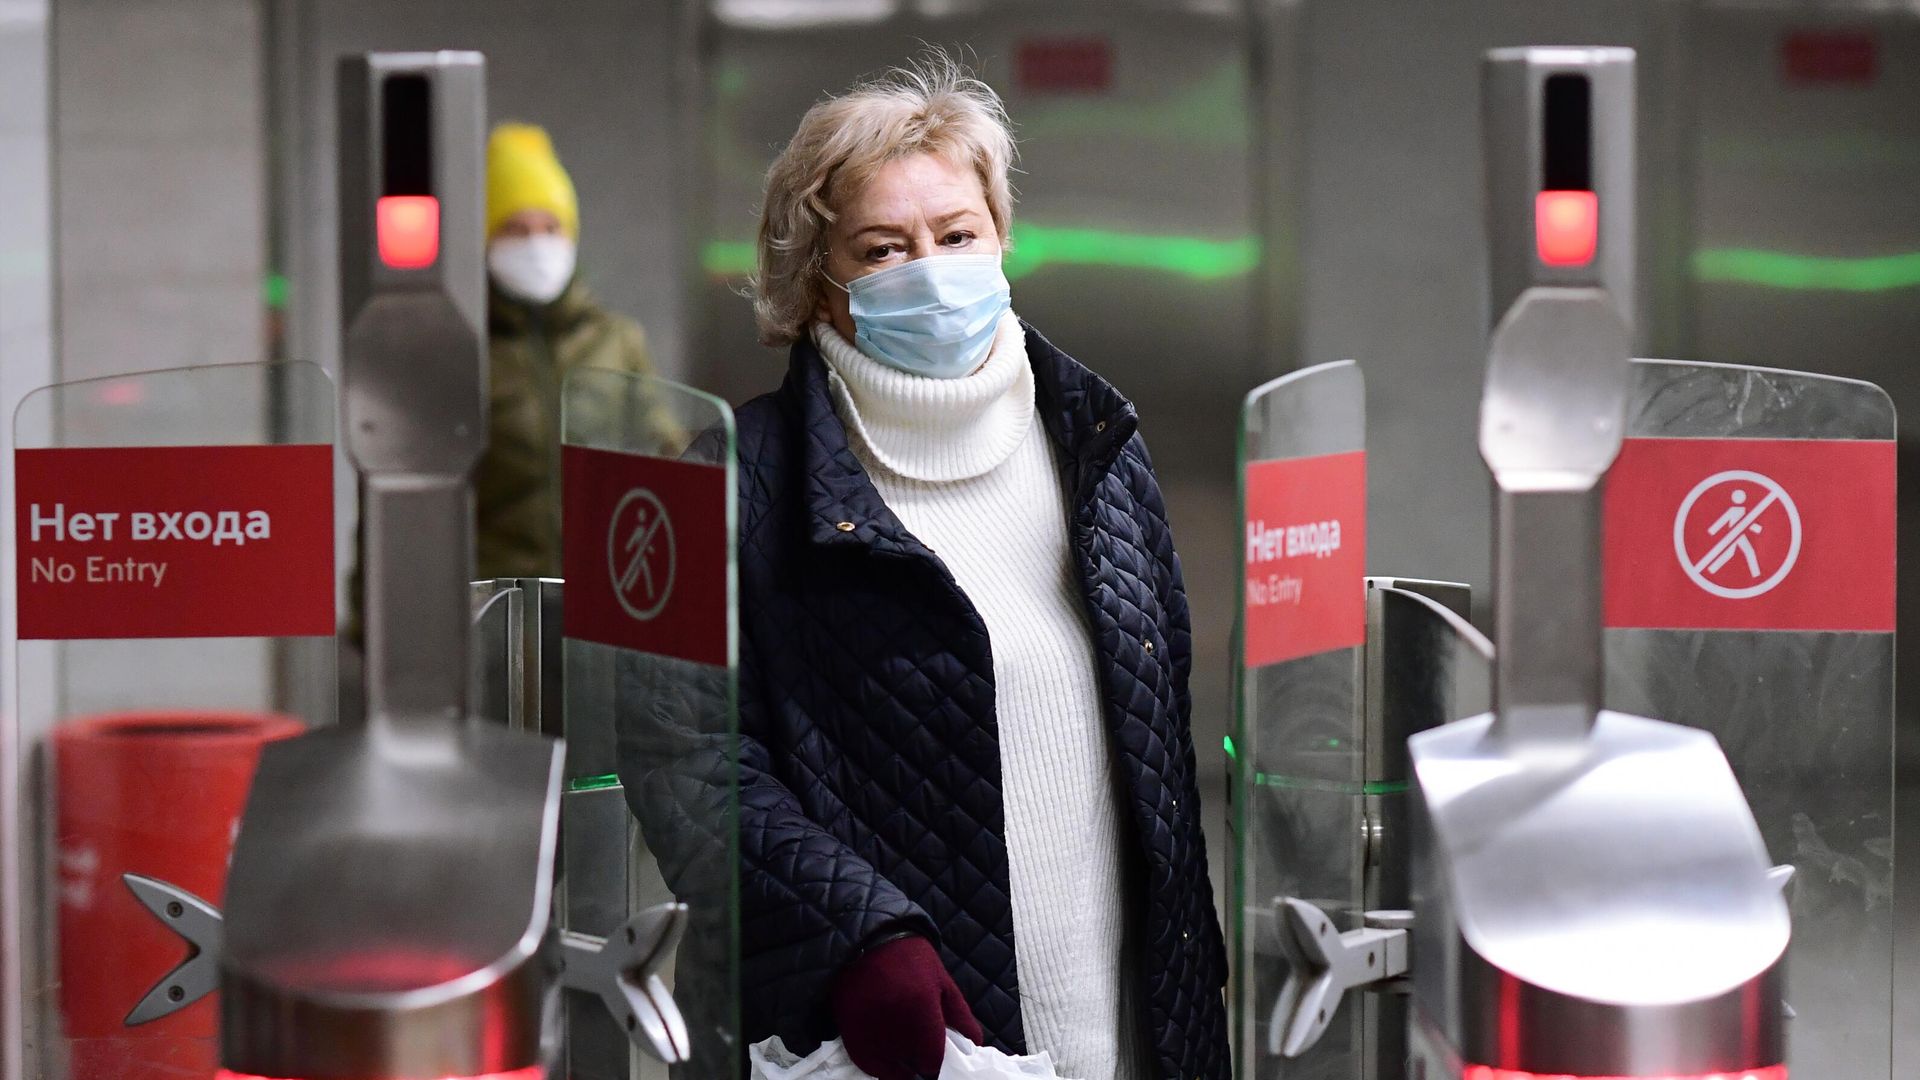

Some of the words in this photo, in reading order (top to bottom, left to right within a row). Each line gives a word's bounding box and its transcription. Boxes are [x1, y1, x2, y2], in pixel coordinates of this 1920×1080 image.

[30, 503, 120, 541] Нет
[131, 510, 271, 546] входа
[1246, 520, 1284, 564] Нет
[1286, 519, 1341, 559] входа
[31, 557, 76, 583] No
[86, 556, 168, 587] Entry
[1269, 573, 1303, 605] Entry
